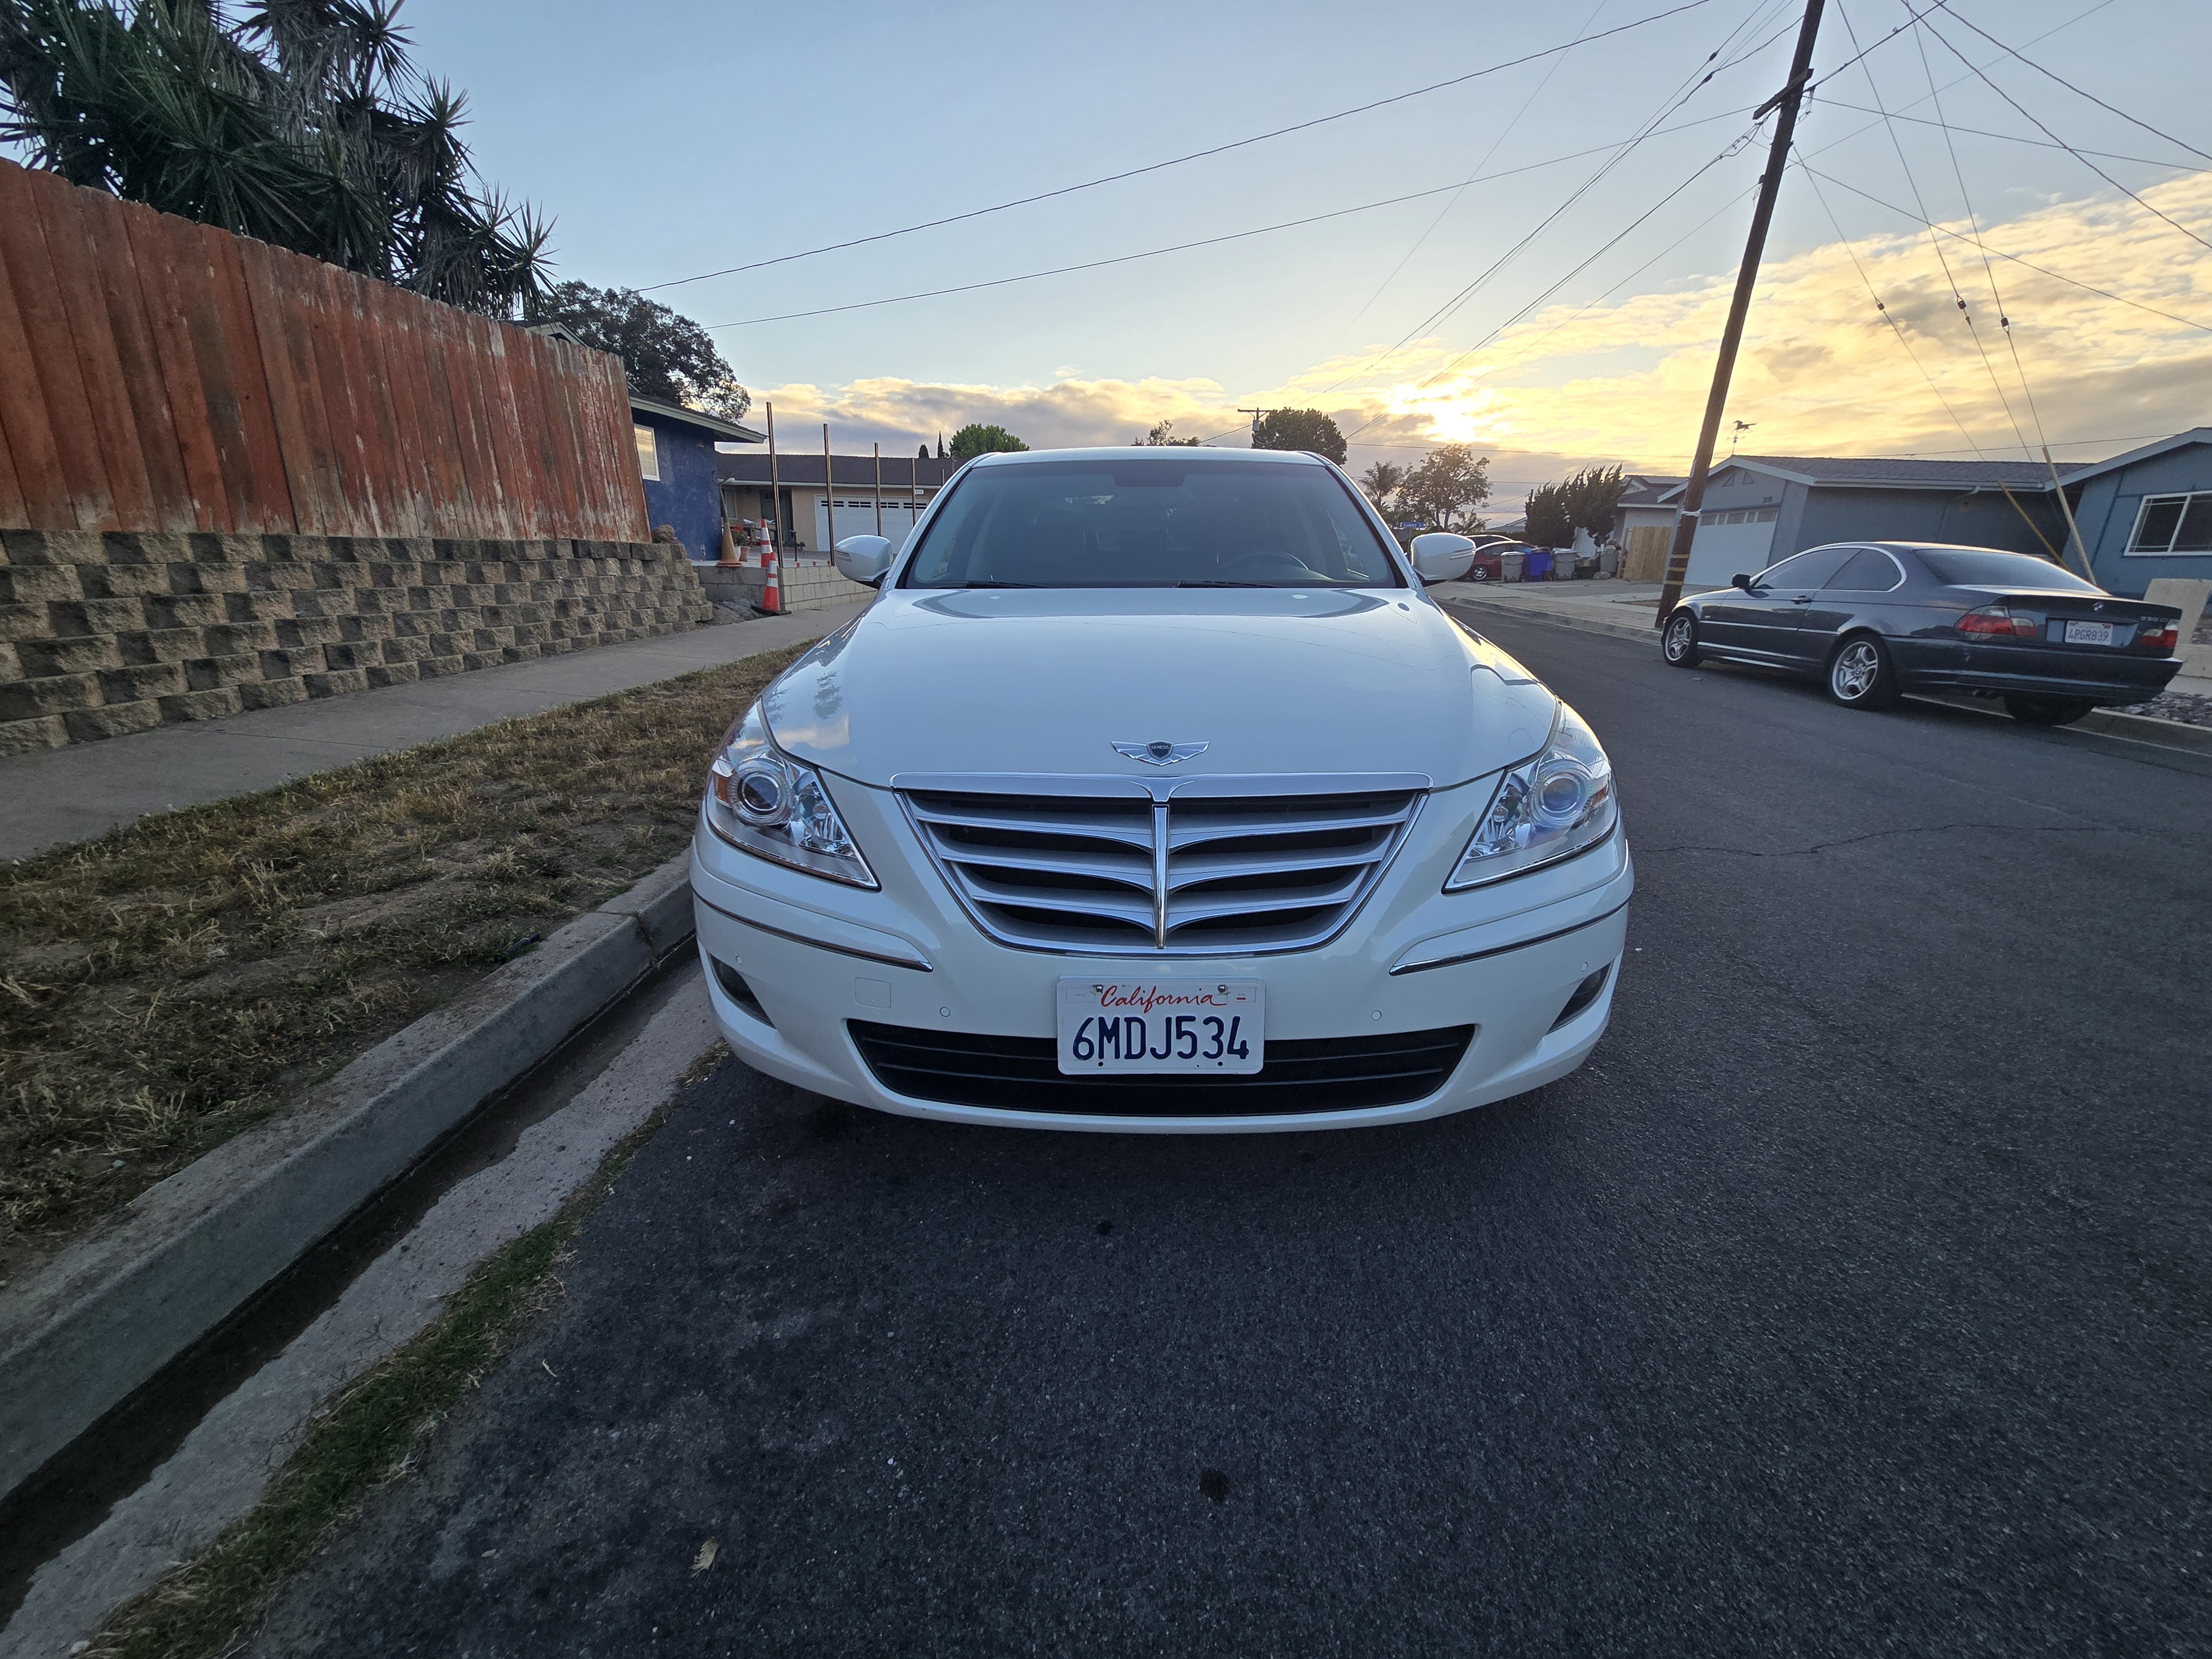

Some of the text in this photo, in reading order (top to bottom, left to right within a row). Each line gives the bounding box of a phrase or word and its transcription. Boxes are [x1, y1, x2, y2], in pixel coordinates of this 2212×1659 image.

[2068, 629, 2109, 641] 4PGR839
[1100, 985, 1227, 1014] California
[1073, 1015, 1250, 1061] 6MDJ534
